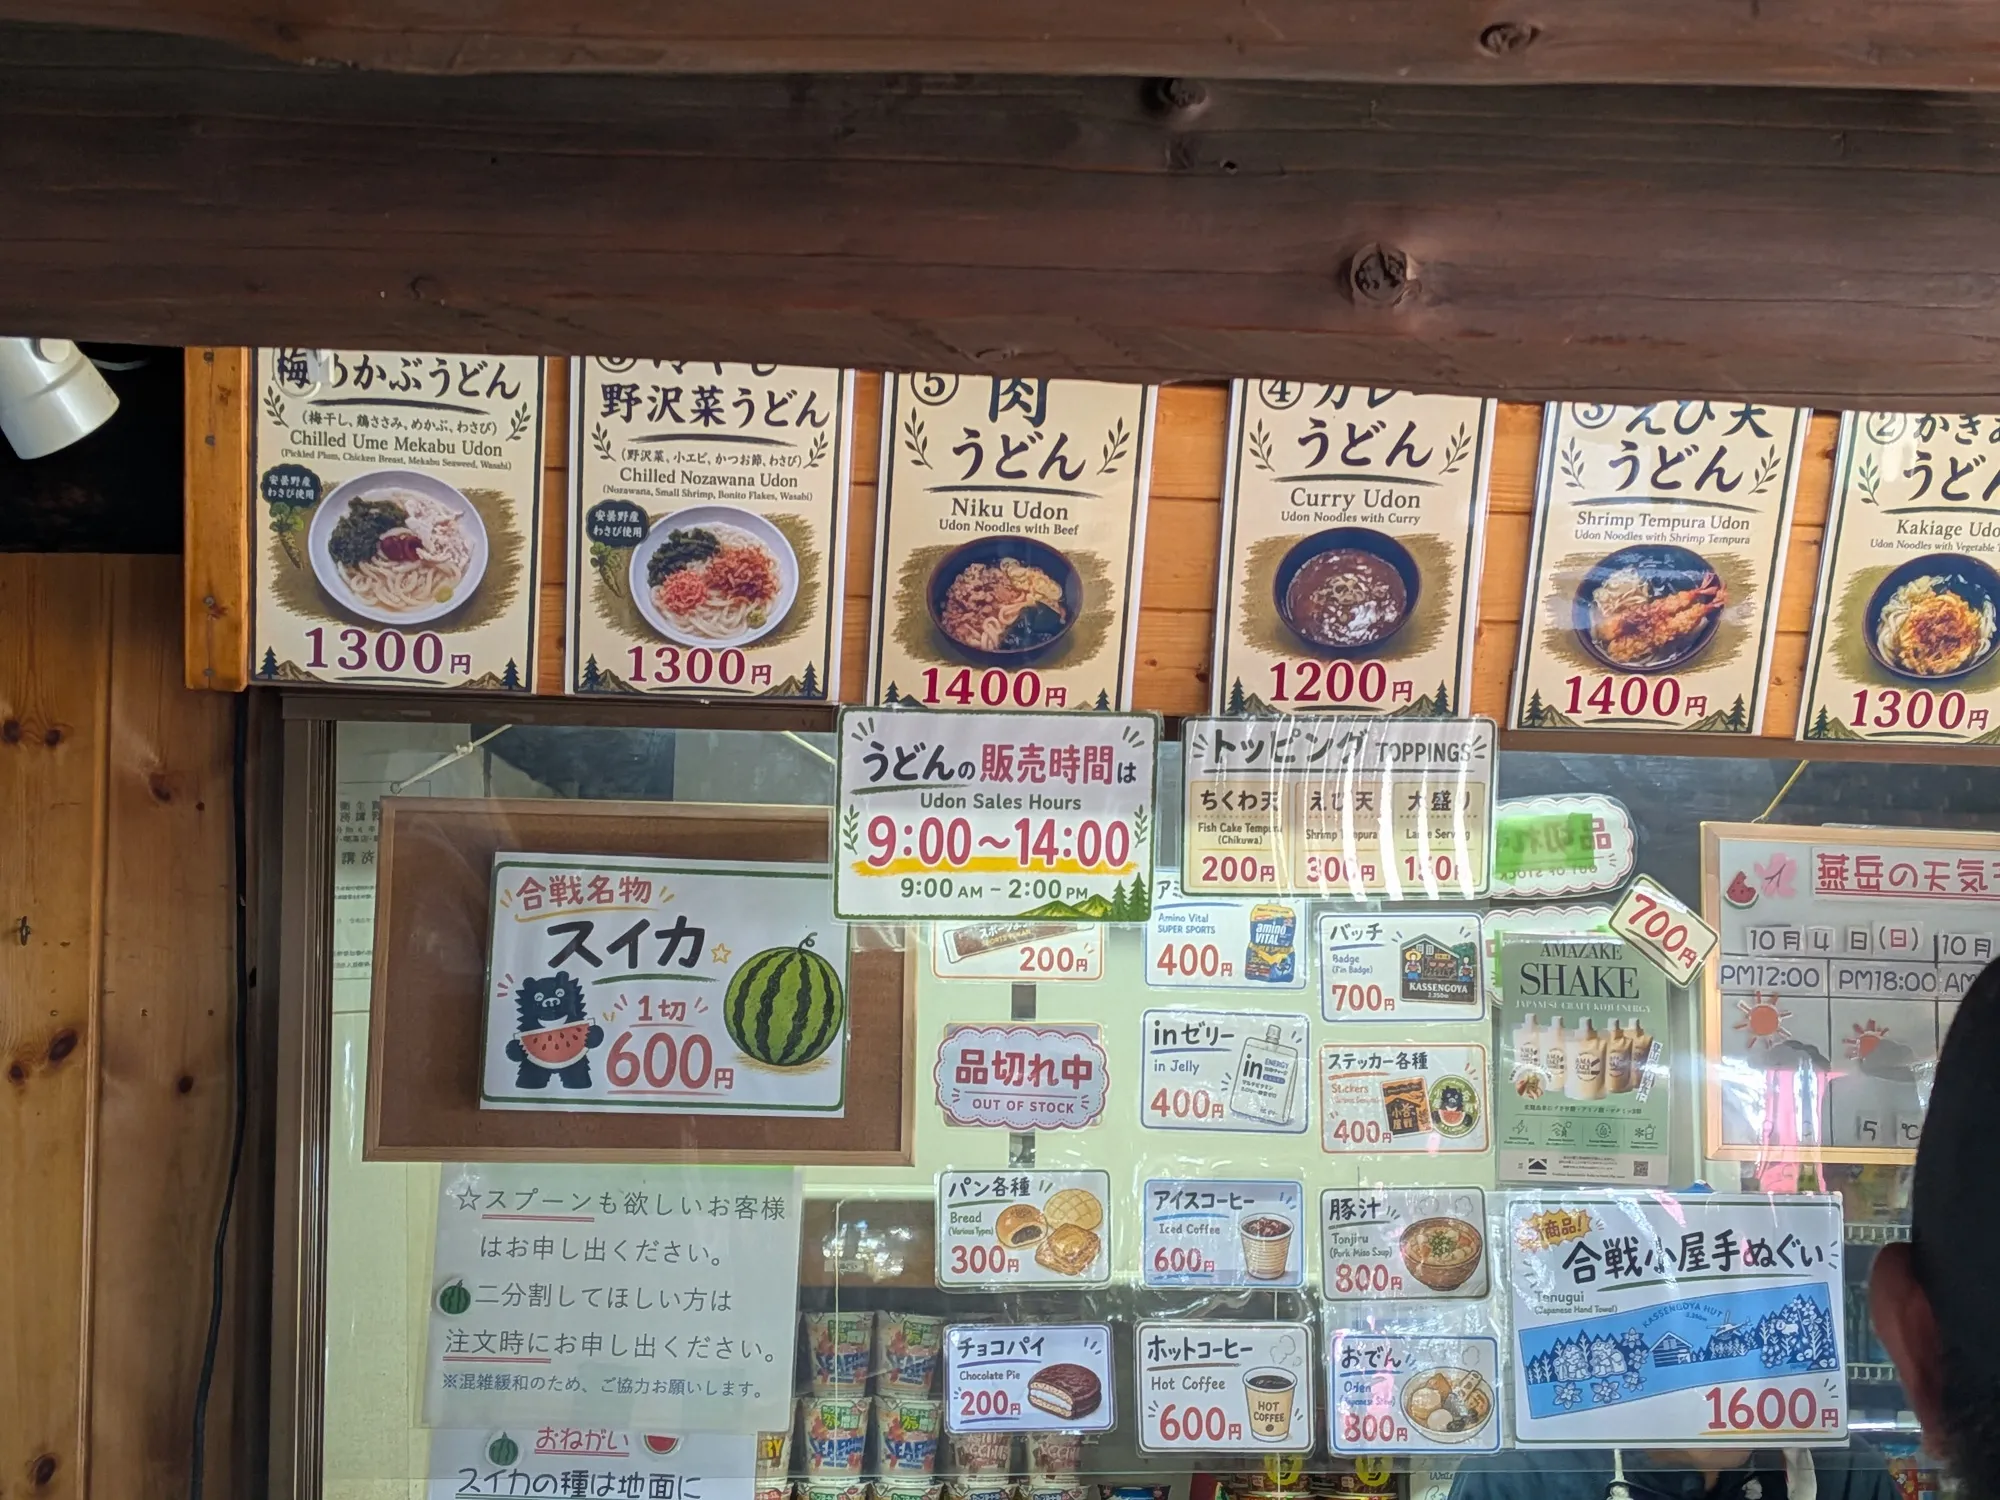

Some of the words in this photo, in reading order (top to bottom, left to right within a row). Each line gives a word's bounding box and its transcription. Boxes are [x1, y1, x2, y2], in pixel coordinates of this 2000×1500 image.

[600, 383, 830, 428] 野沢菜うどん
[290, 429, 346, 448] Chilled
[353, 433, 388, 450] Ume
[394, 436, 455, 454] Mekabu
[462, 440, 503, 457] Udon
[952, 427, 1087, 481] うどん
[1298, 416, 1433, 469] うどん
[619, 467, 676, 485] Chilled
[680, 470, 755, 487] Nozawana
[760, 473, 798, 488] Udon
[1608, 440, 1743, 493] うどん
[655, 487, 680, 498] Small
[681, 489, 716, 500] Shrimp,
[749, 491, 778, 502] Flakes,
[1290, 488, 1355, 512] Curry
[1364, 489, 1421, 509] Udon
[951, 498, 1003, 518] Niku
[1013, 500, 1069, 520] Udon
[1281, 511, 1310, 522] Udon
[1314, 511, 1357, 523] Noodles
[1361, 512, 1384, 523] with
[1388, 513, 1421, 526] Curry
[1577, 511, 1634, 528] Shrimp
[1639, 513, 1706, 530] Tempura
[1710, 515, 1750, 530] Udon
[593, 524, 642, 539] わさび使用
[939, 518, 971, 532] Udon
[974, 520, 1021, 533] Noodles
[1024, 521, 1050, 534] with
[1053, 523, 1080, 536] Beef
[1574, 529, 1601, 540] Udon
[1603, 530, 1643, 542] Noodles
[1646, 531, 1667, 543] with
[1669, 532, 1705, 546] Shrimp
[1708, 534, 1750, 546] Tempura
[1897, 519, 1963, 540] Kakiage
[1870, 539, 1894, 549] Udon
[1896, 540, 1932, 550] Noodles
[1935, 541, 1953, 551] with
[1956, 542, 1995, 553] Vegetable
[305, 627, 471, 675] 1300円
[627, 646, 772, 686] 1300円
[921, 667, 1067, 708] 1400円
[1270, 661, 1413, 703] 1200円
[1564, 675, 1708, 717] 1400円
[1849, 689, 1989, 731] 1300円
[1214, 728, 1368, 765] トッピング
[1376, 741, 1471, 764] TOPPINGS
[862, 741, 1137, 785] うどんの販売時間は
[920, 792, 966, 810] Udon
[973, 793, 1022, 811] Sales
[1029, 794, 1082, 811] Hours
[1200, 791, 1279, 811] ちくわ天
[1198, 822, 1217, 834] Fish
[1219, 823, 1243, 835] Cake
[1218, 834, 1263, 846] (Chikuwa)
[1306, 828, 1337, 841] Shrimp
[1202, 855, 1275, 883] 200円
[1817, 853, 2000, 893] 燕岳の天気
[516, 874, 652, 911] 合戦名物
[901, 878, 953, 899] 9:00
[958, 886, 982, 898] AM
[1008, 879, 1061, 900] 2:00
[1066, 887, 1088, 900] PM
[1158, 912, 1186, 923] Amino
[1189, 913, 1209, 923] Vital
[1256, 921, 1287, 935] amino
[547, 915, 706, 969] スイカ
[1158, 925, 1184, 934] SUPER
[1186, 925, 1216, 935] SPORTS
[1255, 932, 1279, 946] VITAL
[1330, 922, 1383, 941] バッチ
[1628, 892, 1698, 969] 700円
[1019, 946, 1088, 972] 200円
[1157, 943, 1233, 977] 400円
[1332, 954, 1360, 965] Badge
[1540, 944, 1623, 961] AMAZAKE
[1348, 965, 1373, 975] Badge)
[1520, 962, 1640, 999] SHAKE
[1721, 965, 1820, 988] PM12:00
[1839, 970, 1936, 992] PM18:00
[1331, 984, 1395, 1012] 700円
[1409, 982, 1468, 993] KASSENGOYA
[638, 995, 686, 1022] 1切
[1154, 1020, 1235, 1046] inゼリー
[606, 1030, 734, 1090] 600円
[955, 1049, 1093, 1090] 品切れ中
[1154, 1060, 1166, 1072] in
[1170, 1060, 1200, 1075] Jelly
[1243, 1053, 1263, 1080] in
[1328, 1052, 1428, 1070] ステッカー各種
[972, 1098, 999, 1110] OUT
[1006, 1100, 1024, 1111] OF
[1029, 1101, 1074, 1114] STOCK
[1151, 1088, 1224, 1119] 400円
[1334, 1119, 1392, 1144] 400円
[948, 1176, 1031, 1197] パン各種
[1154, 1190, 1255, 1211] アイスコーヒー
[1329, 1198, 1382, 1221] 豚汁
[950, 1212, 981, 1224] Bread
[1159, 1224, 1183, 1235] Iced
[1186, 1223, 1220, 1235] Coffee
[948, 1226, 974, 1237] (Various
[975, 1226, 994, 1237] Types)
[1331, 1233, 1369, 1247] Tonjiru
[480, 1235, 721, 1267] はお申し出ください。
[951, 1245, 1020, 1274] 300円
[1154, 1247, 1215, 1273] 600円
[1562, 1228, 1824, 1284] 合戦小屋手ぬぐい
[1335, 1263, 1403, 1293] 800円
[475, 1282, 732, 1313] 二分割してほしい方は
[1534, 1291, 1585, 1306] Tenugui
[1574, 1305, 1593, 1313] Hand
[1704, 1304, 1723, 1317] HUT
[445, 1328, 774, 1363] 注文時にお申し出ください。
[957, 1336, 1045, 1359] チョコパイ
[1147, 1335, 1253, 1362] ホットコーヒー
[1341, 1347, 1402, 1369] おでん
[959, 1370, 1004, 1381] Chocolate
[1006, 1370, 1021, 1380] Pie
[1151, 1377, 1176, 1390] Hot
[1182, 1375, 1226, 1392] Coffee
[961, 1390, 1021, 1416] 200円
[1258, 1401, 1280, 1411] HOT
[1706, 1386, 1839, 1430] 1600円
[1160, 1404, 1242, 1441] 600円
[1253, 1411, 1285, 1423] COFFEE
[1344, 1412, 1408, 1442] 800円
[535, 1426, 629, 1452] おねがい
[457, 1467, 701, 1499] スイカの種は地面に
